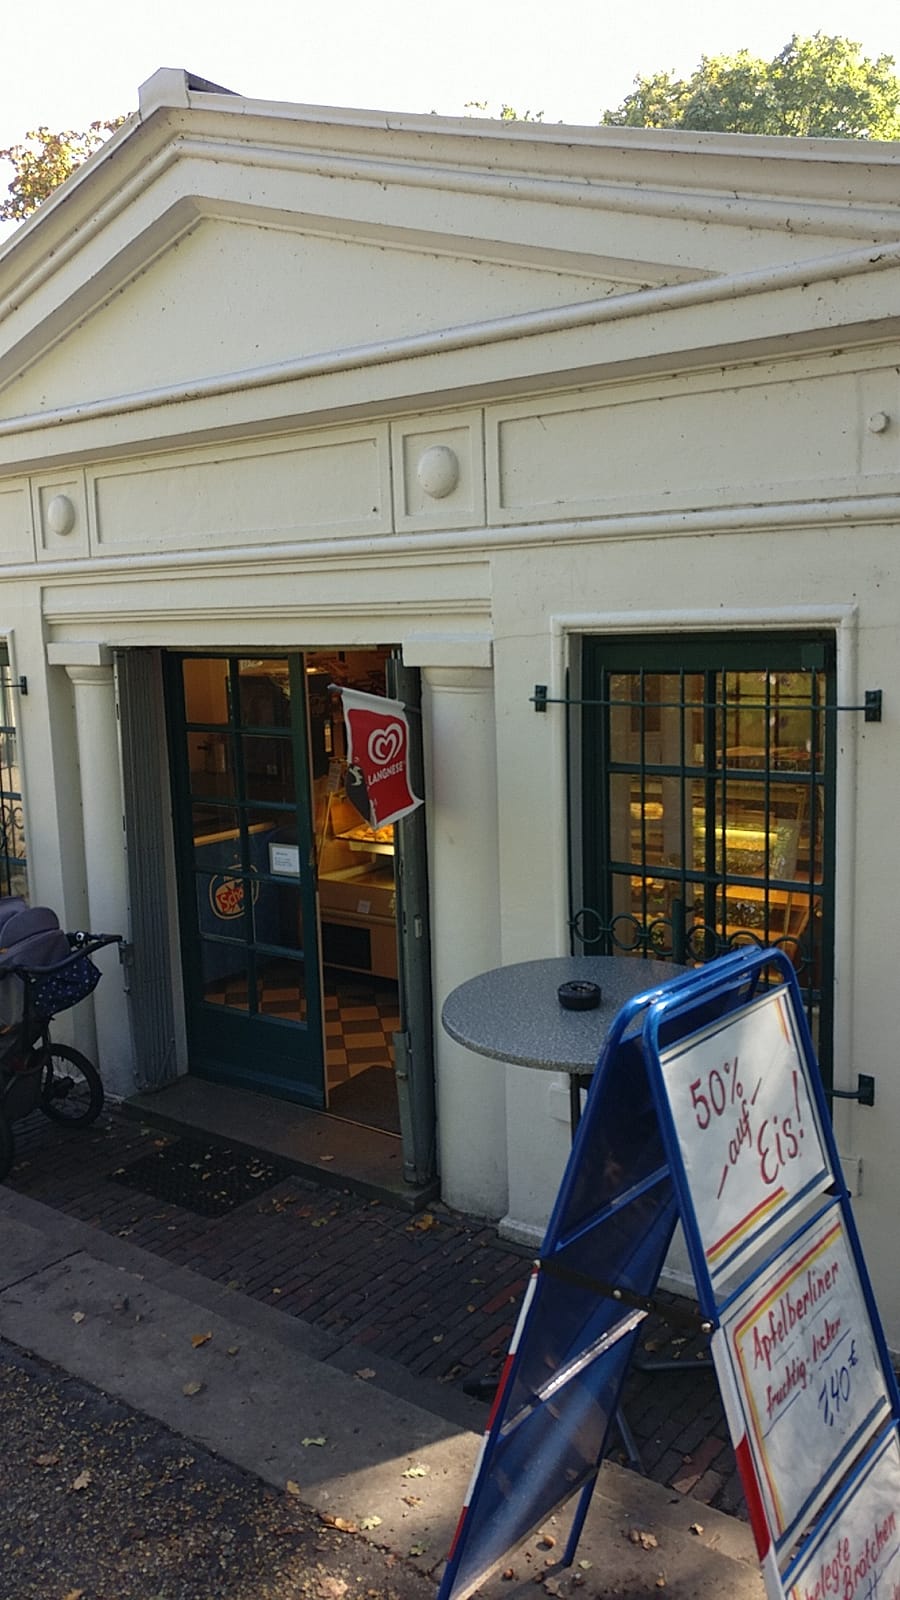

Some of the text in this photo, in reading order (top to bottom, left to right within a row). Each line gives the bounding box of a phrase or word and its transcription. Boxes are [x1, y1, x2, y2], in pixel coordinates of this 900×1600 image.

[367, 761, 404, 786] LANGNESE
[689, 1056, 743, 1130] 50%
[753, 1261, 839, 1371] Apfelberliner
